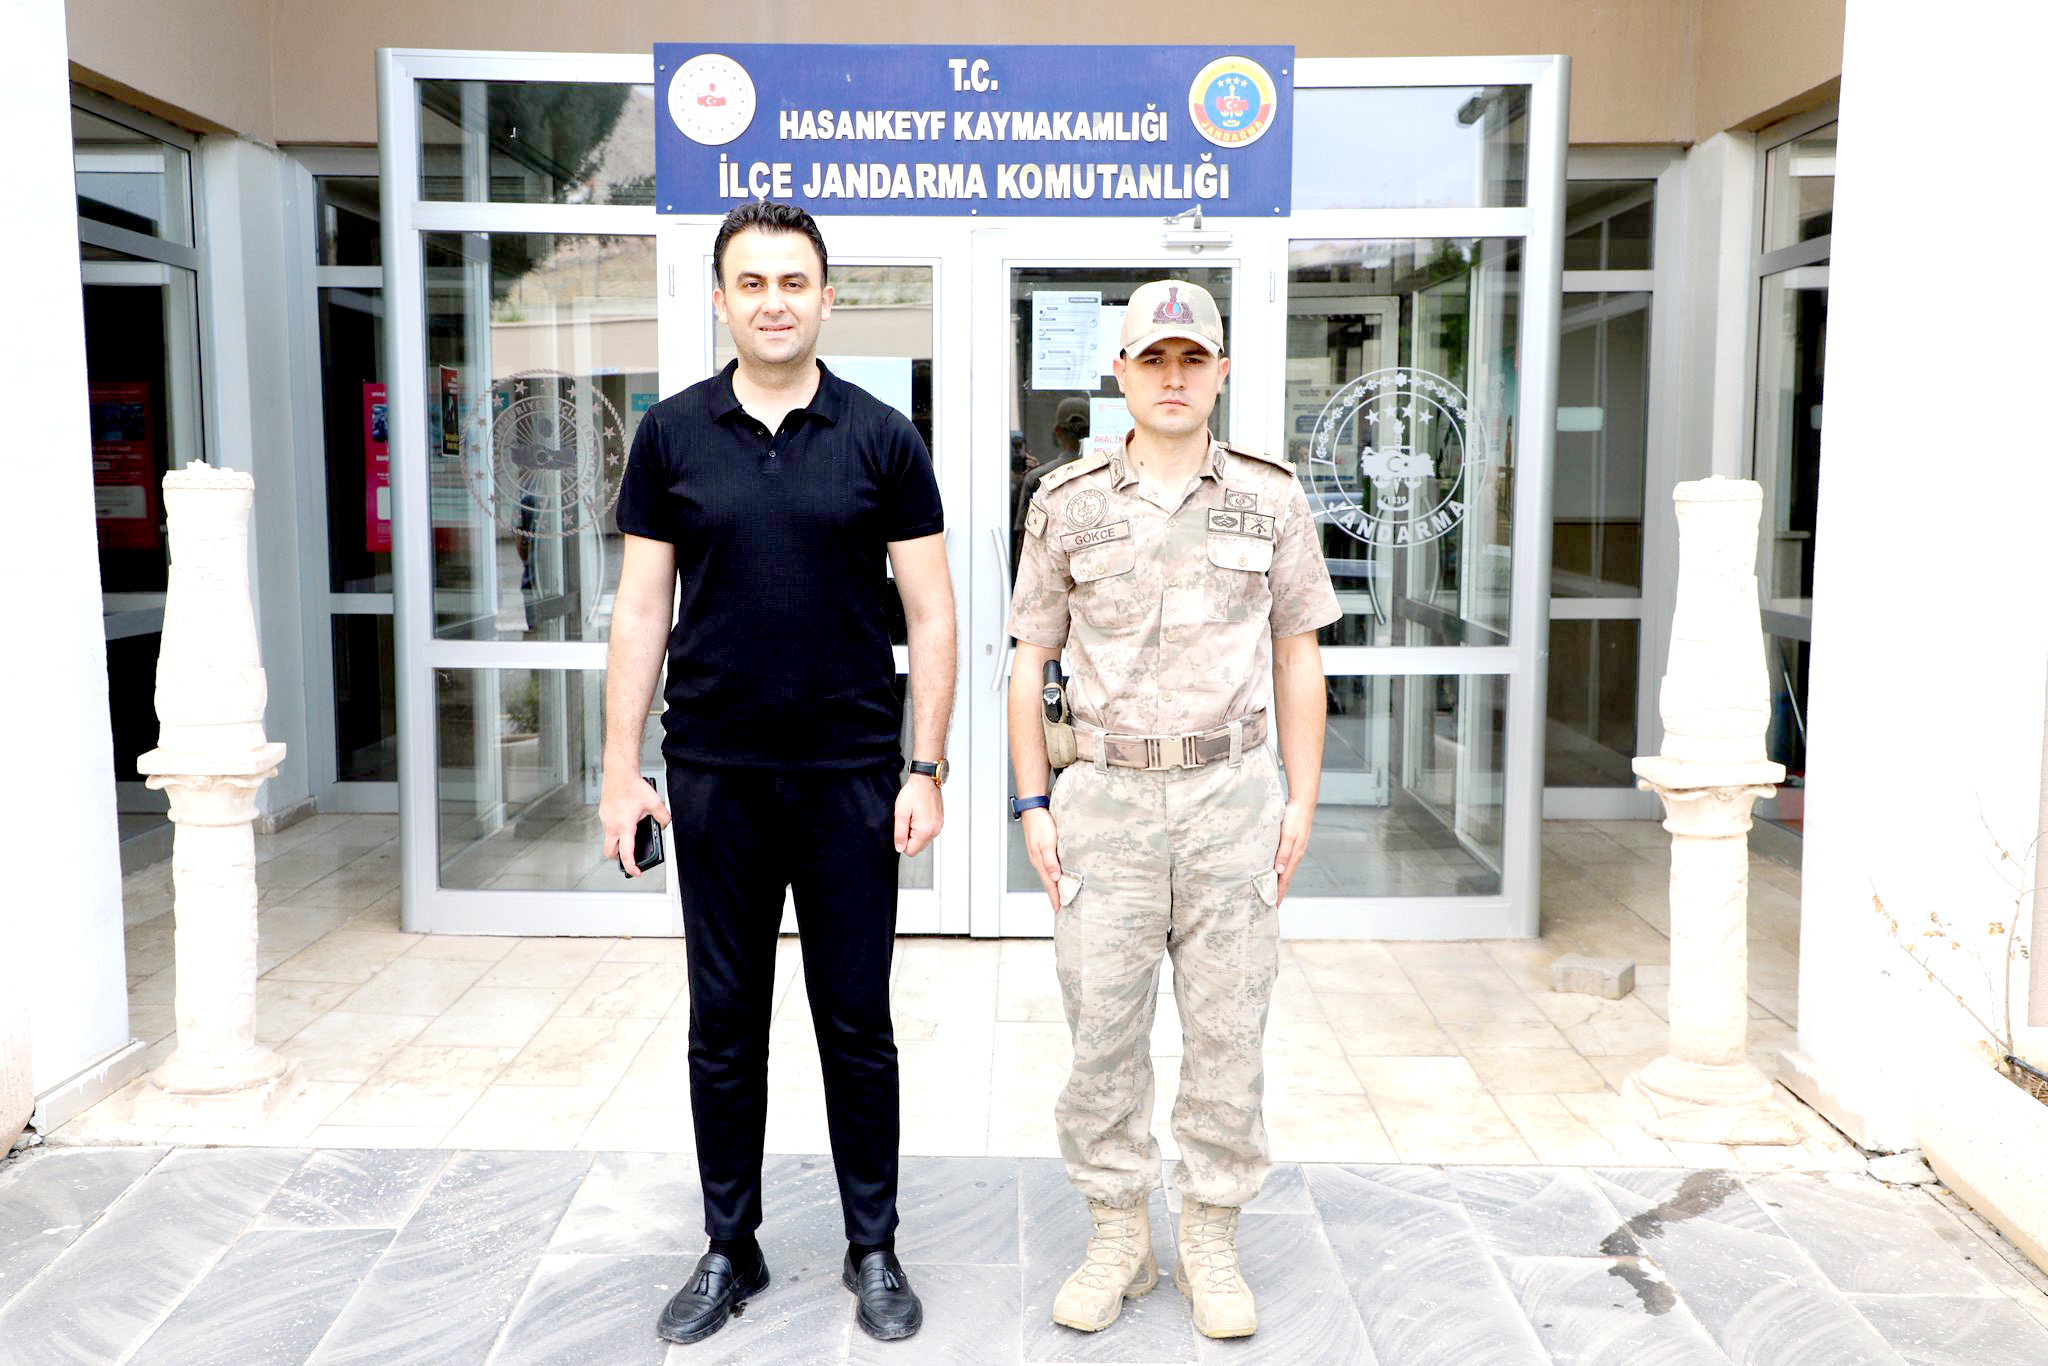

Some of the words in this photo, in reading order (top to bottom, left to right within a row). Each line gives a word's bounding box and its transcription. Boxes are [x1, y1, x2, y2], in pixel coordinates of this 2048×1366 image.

[948, 58, 999, 93] T.C.
[779, 109, 946, 141] HASANKEYF
[953, 103, 1168, 142] KAYMAKAMLIĞI
[1201, 121, 1263, 142] JANDARMA
[719, 153, 793, 204] İLÇE
[802, 162, 988, 199] JANDARMA
[996, 152, 1229, 200] KOMUTANLIĞI
[1387, 496, 1407, 505] 1839
[1328, 500, 1465, 544] JANDARMA
